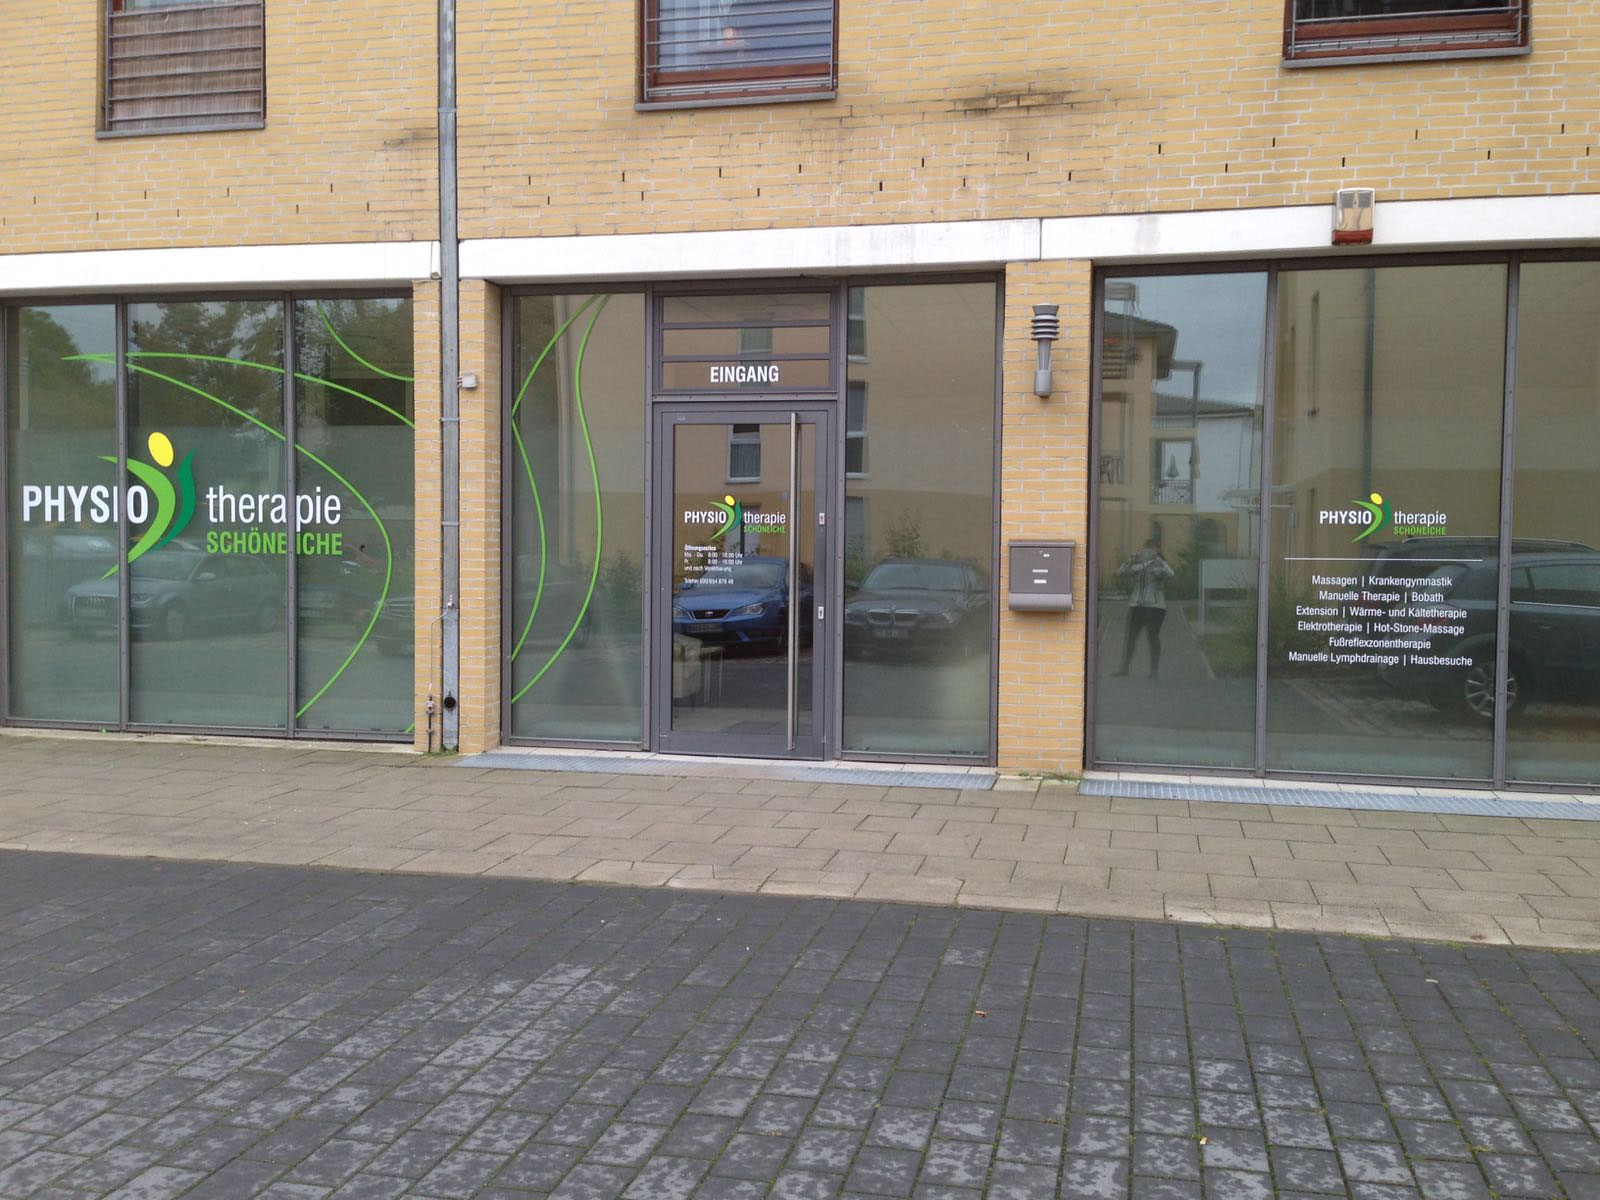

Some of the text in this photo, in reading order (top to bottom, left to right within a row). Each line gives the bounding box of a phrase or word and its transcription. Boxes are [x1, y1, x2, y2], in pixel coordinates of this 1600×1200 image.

[710, 365, 780, 383] EINGANG
[22, 484, 342, 532] PHYSIO therapie
[684, 511, 786, 526] PHYSIO therapie
[1319, 510, 1447, 527] PHYSIO therapie
[206, 527, 343, 556] SCHÖNEICHE
[1311, 575, 1358, 588] Massagen
[1368, 576, 1453, 588] Krankengymnastik
[1319, 590, 1359, 601] Manuelle
[1361, 591, 1400, 603] Therapie
[1411, 592, 1444, 603] Bobath
[1296, 605, 1339, 616] Extension
[1349, 606, 1386, 617] Wärme-
[1388, 607, 1406, 617] und
[1408, 607, 1468, 620] Kältetherapie
[1297, 621, 1363, 633] Elektrotherapie
[1373, 622, 1465, 635] Hot-Stone-Massage
[1329, 636, 1432, 649] Fußreflexzonentherapie
[1288, 651, 1328, 662] Manuelle
[1330, 652, 1399, 665] Lymphdrainage
[1410, 654, 1473, 666] Hausbesuche
